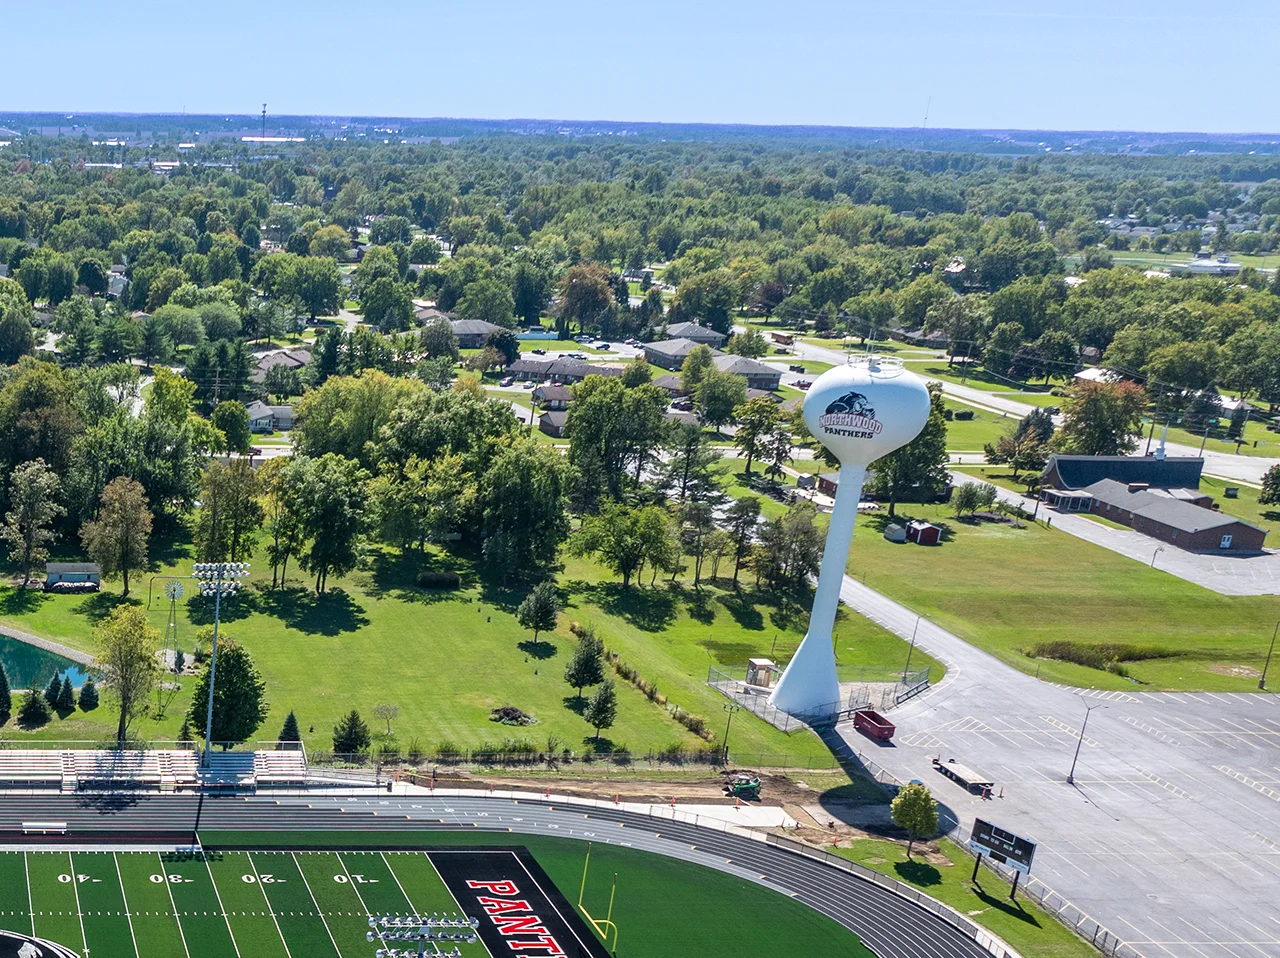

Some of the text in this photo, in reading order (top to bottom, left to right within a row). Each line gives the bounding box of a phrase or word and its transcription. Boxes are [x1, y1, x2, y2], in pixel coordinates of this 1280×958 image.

[819, 413, 883, 435] NORTHWOOD
[825, 427, 874, 439] PANTHERS
[57, 873, 91, 883] 40
[150, 873, 183, 883] 30
[242, 873, 275, 883] 20
[334, 873, 368, 883] 10
